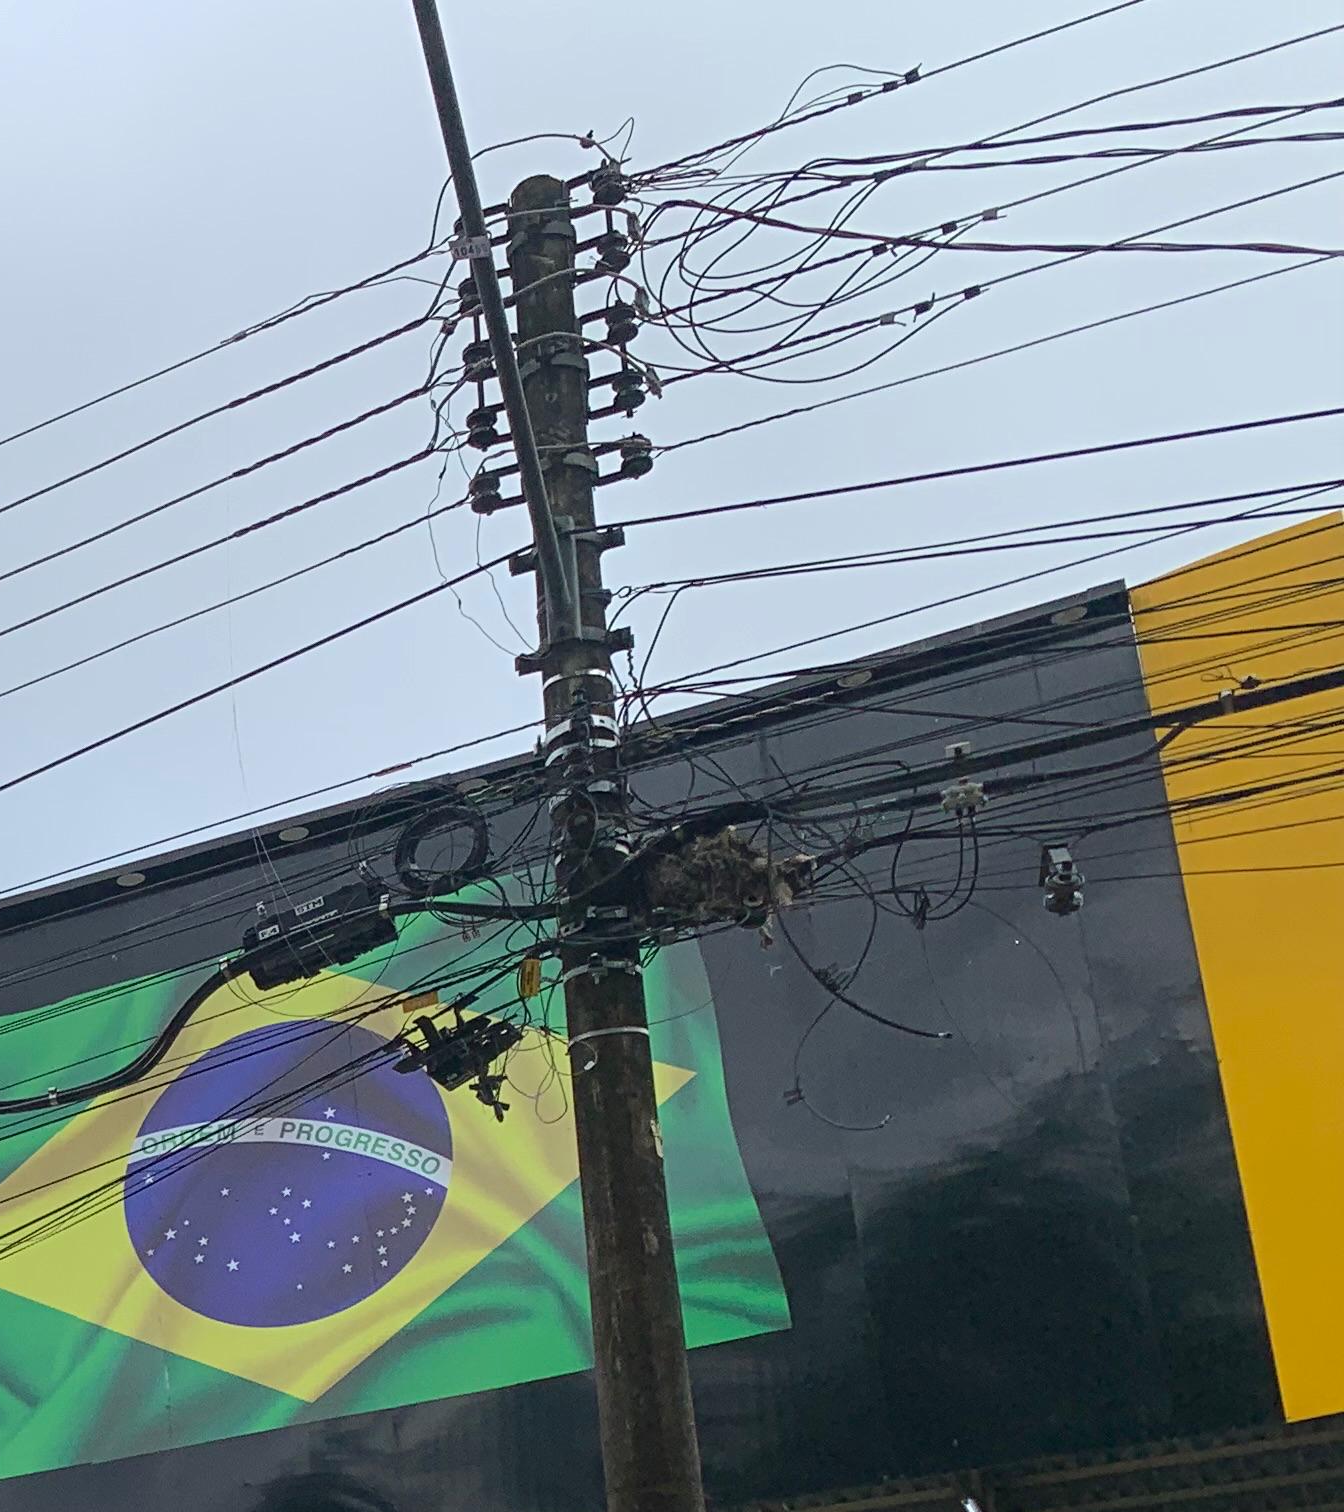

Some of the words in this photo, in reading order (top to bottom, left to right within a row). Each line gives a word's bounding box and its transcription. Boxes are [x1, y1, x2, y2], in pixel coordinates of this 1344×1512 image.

[141, 1123, 237, 1156] ORDEM
[253, 1124, 265, 1136] E
[279, 1121, 441, 1175] PROGRESSO
